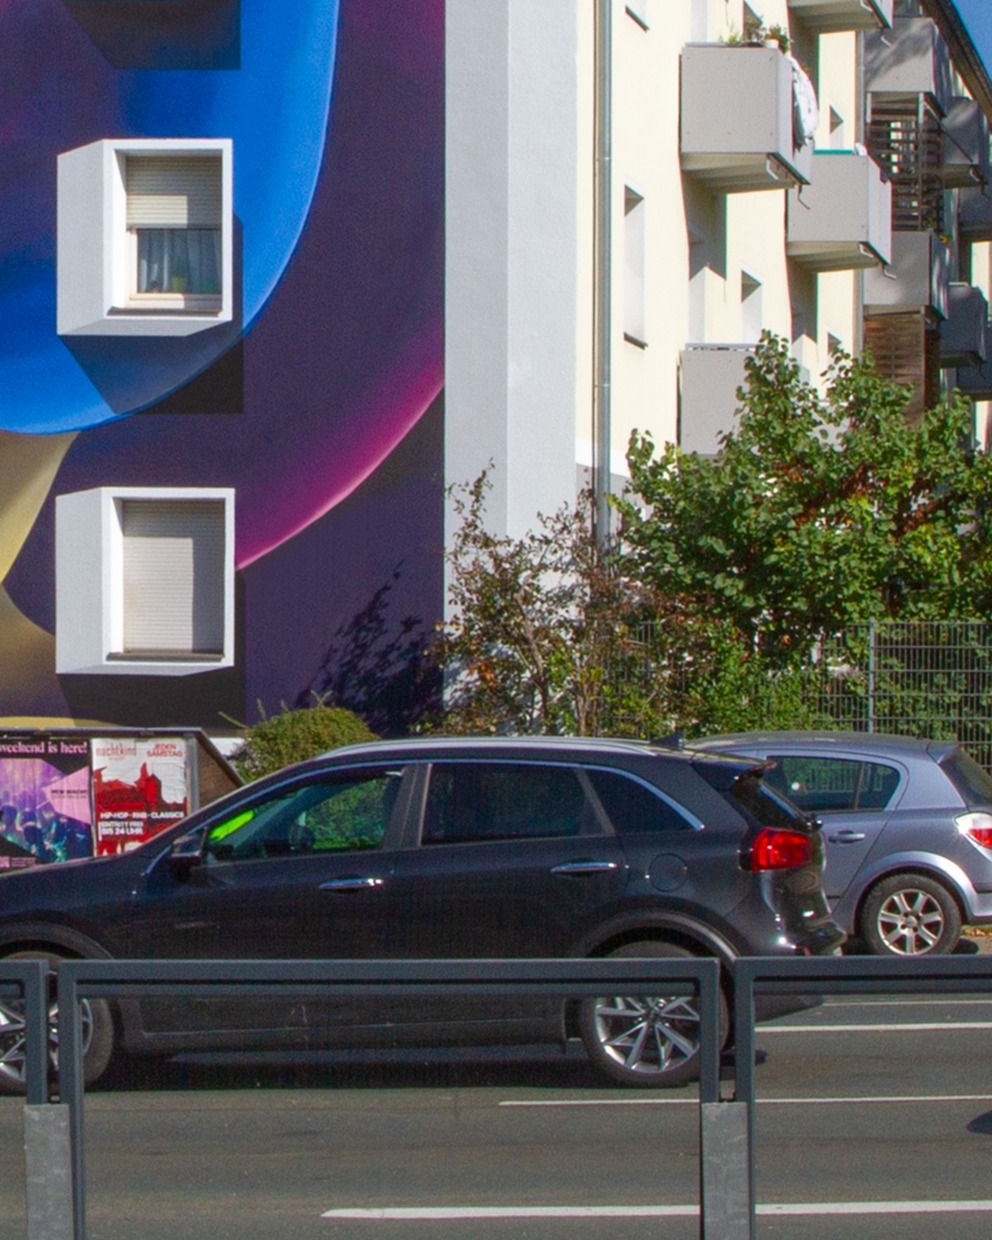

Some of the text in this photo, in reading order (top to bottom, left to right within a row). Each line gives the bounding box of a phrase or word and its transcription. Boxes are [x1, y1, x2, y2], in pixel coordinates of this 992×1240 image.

[48, 741, 58, 754] is
[60, 741, 88, 754] here!
[150, 811, 185, 819] CLASSICS
